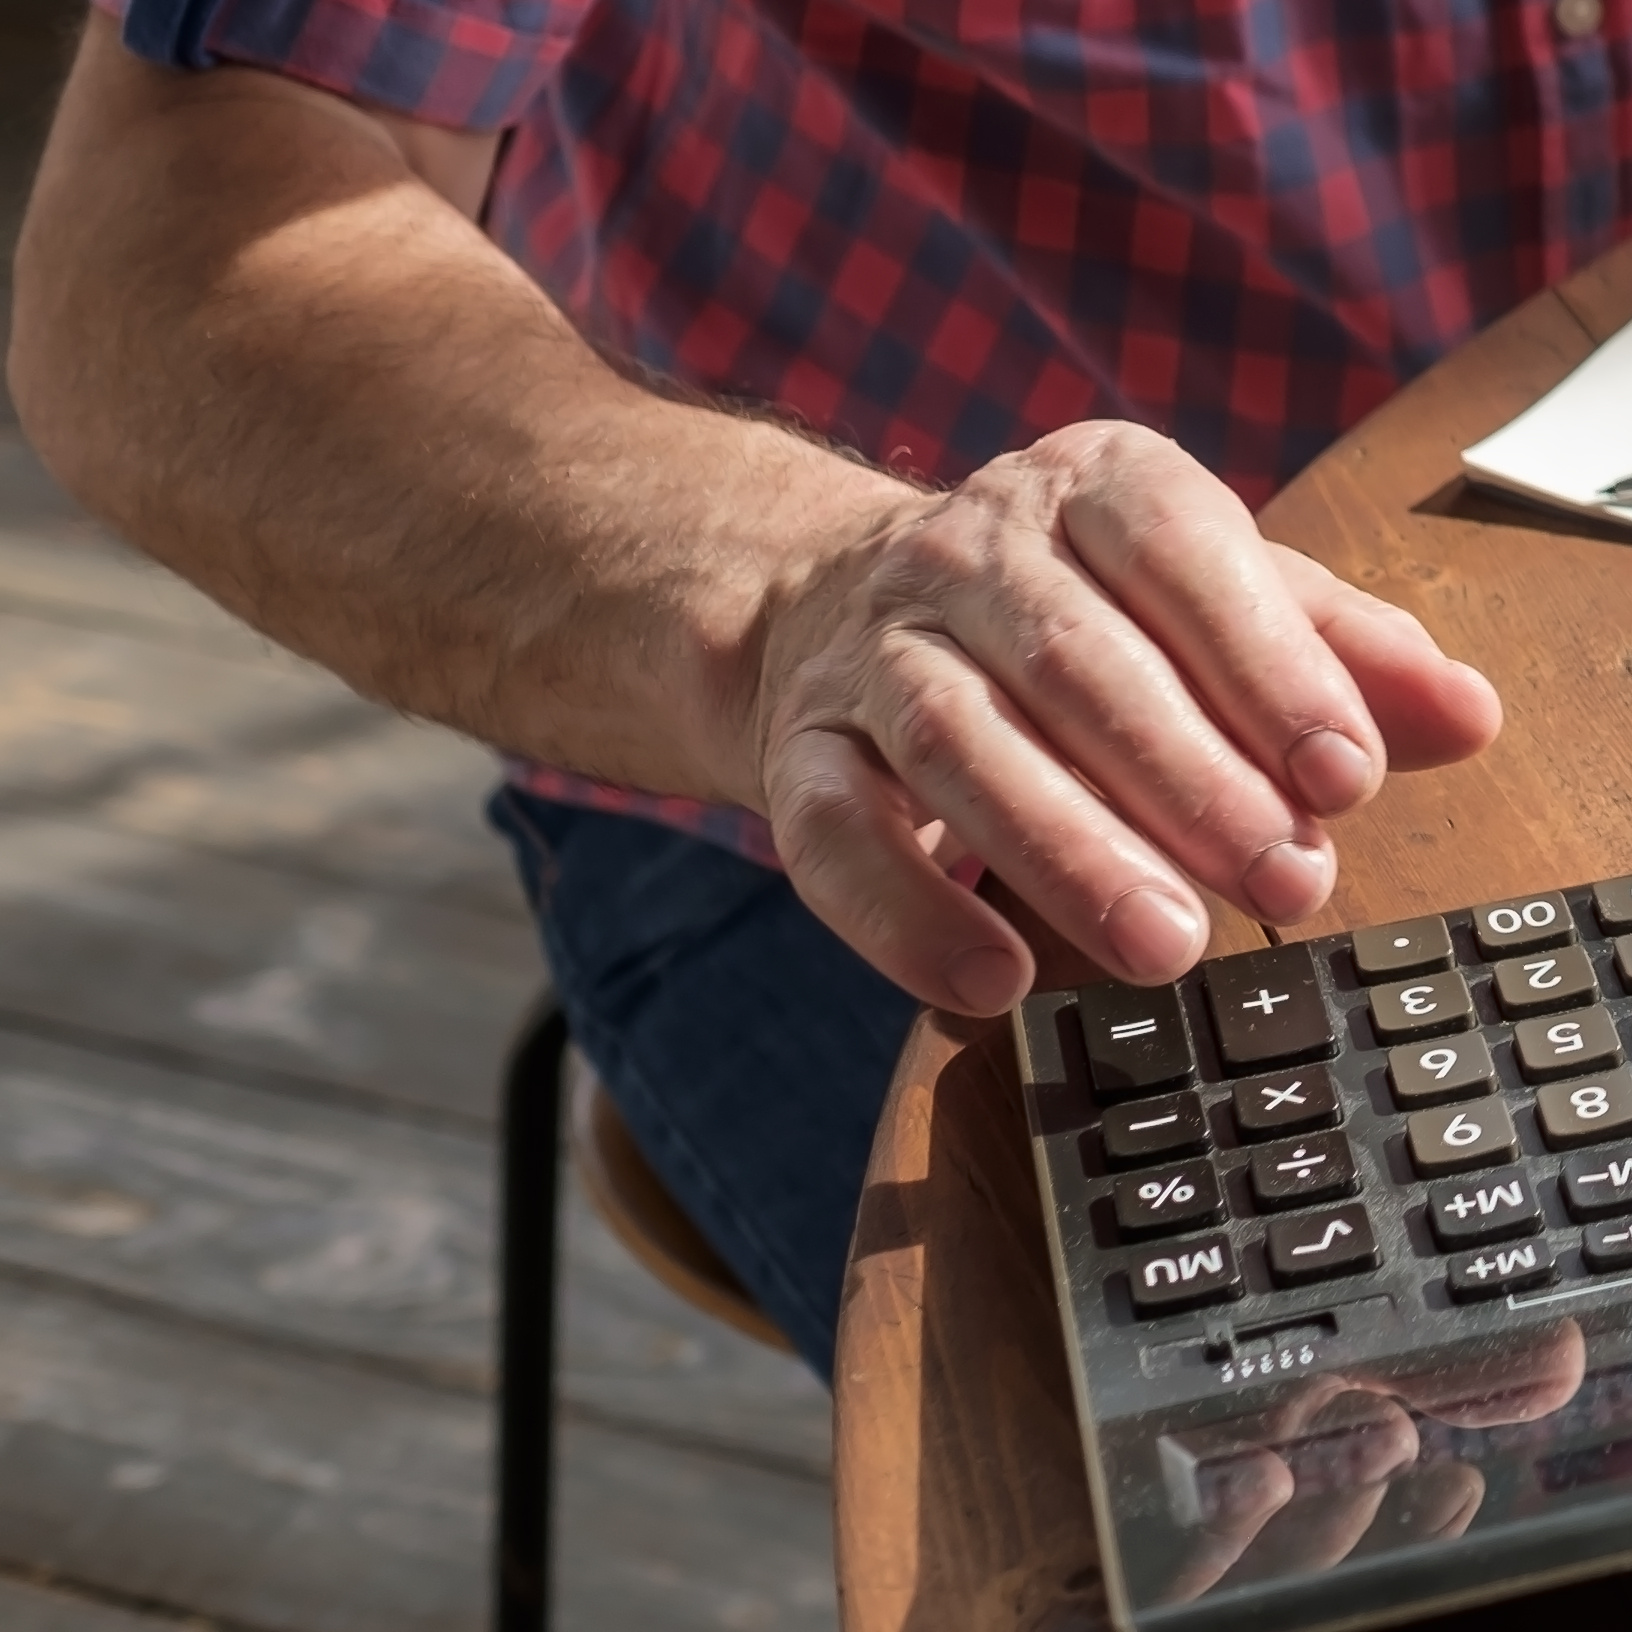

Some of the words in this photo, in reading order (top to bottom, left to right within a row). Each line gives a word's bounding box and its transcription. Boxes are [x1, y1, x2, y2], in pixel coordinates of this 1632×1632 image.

[1488, 902, 1555, 933] 00
[1524, 960, 1561, 988] 2
[1400, 987, 1436, 1014] 3
[1548, 1023, 1583, 1053] 5
[1420, 1049, 1457, 1079] 6
[1571, 1087, 1609, 1118] 8
[1444, 1114, 1481, 1145] 9
[1139, 1176, 1194, 1209] %
[1445, 1181, 1523, 1218] M+
[1145, 1246, 1223, 1286] MU
[1467, 1245, 1536, 1279] M+
